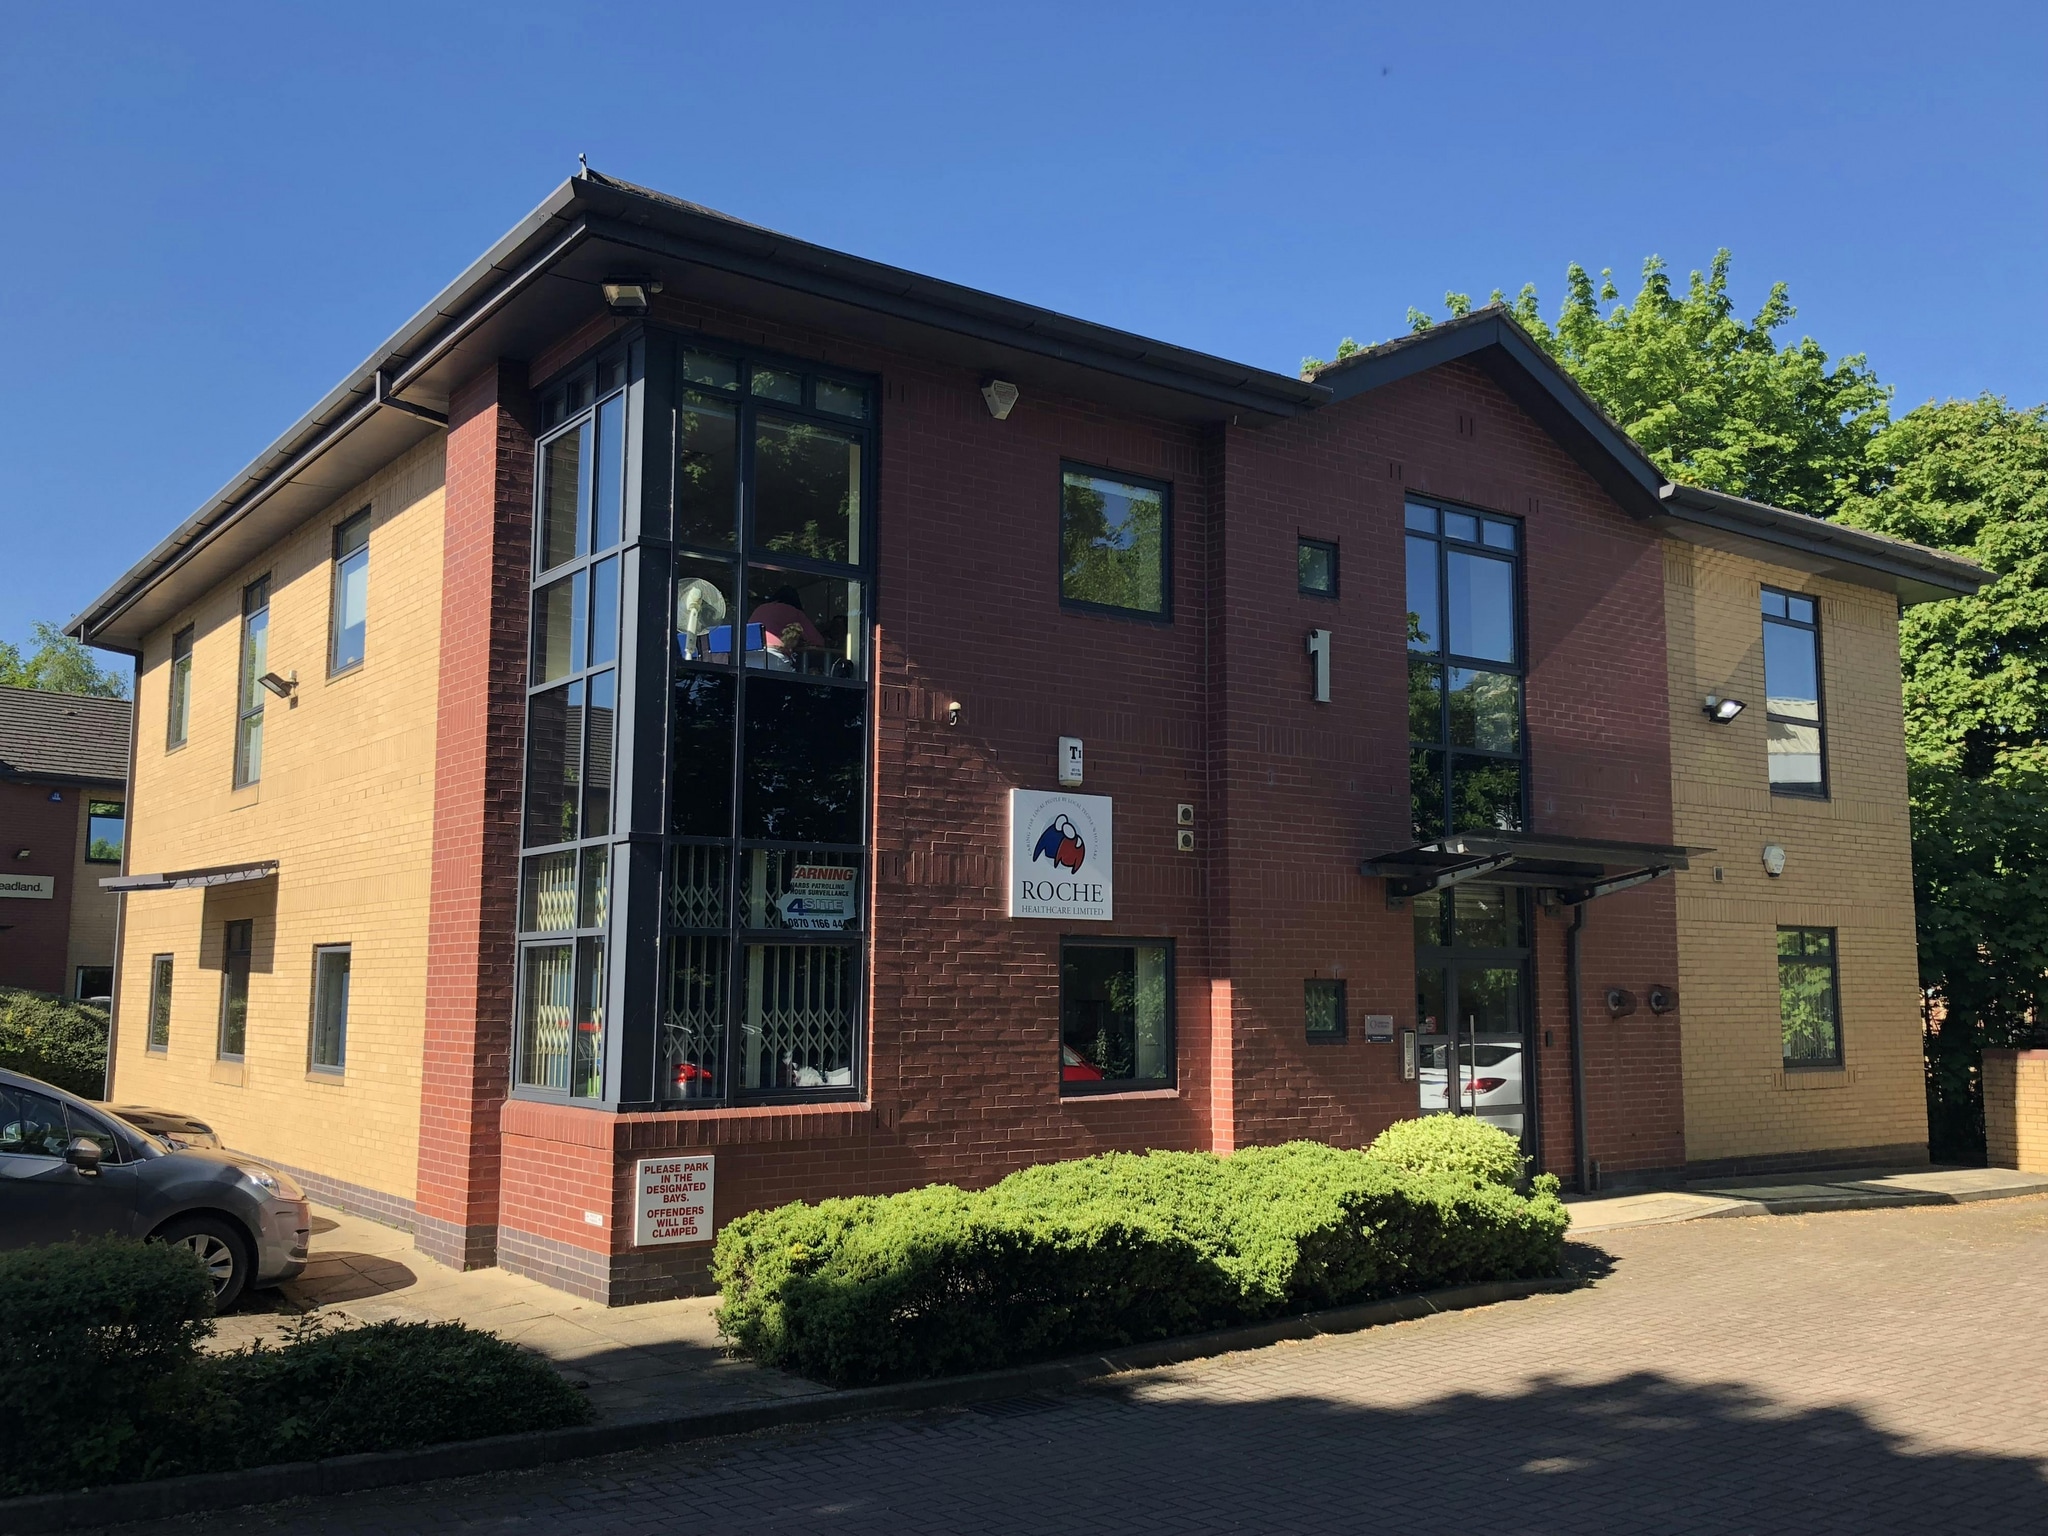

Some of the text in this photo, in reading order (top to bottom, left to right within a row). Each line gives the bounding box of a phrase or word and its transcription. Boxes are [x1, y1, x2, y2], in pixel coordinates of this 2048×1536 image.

[0, 881, 43, 892] eadland.
[811, 882, 845, 890] PATROLLING
[1022, 880, 1104, 903] ROCHE
[808, 889, 849, 897] SURVEILLANCE
[1021, 905, 1104, 916] HEALTHCARE LIMITED
[787, 918, 809, 928] 0870
[811, 918, 830, 929] 1166
[644, 1162, 709, 1175] PLEASE PARK
[661, 1173, 693, 1183] IN THE
[646, 1182, 706, 1195] DESIGNATED
[663, 1193, 690, 1203] BAYS.
[646, 1205, 705, 1219] OFFENDERS
[656, 1216, 695, 1228] WILL BE
[652, 1226, 698, 1238] CLAMPED
